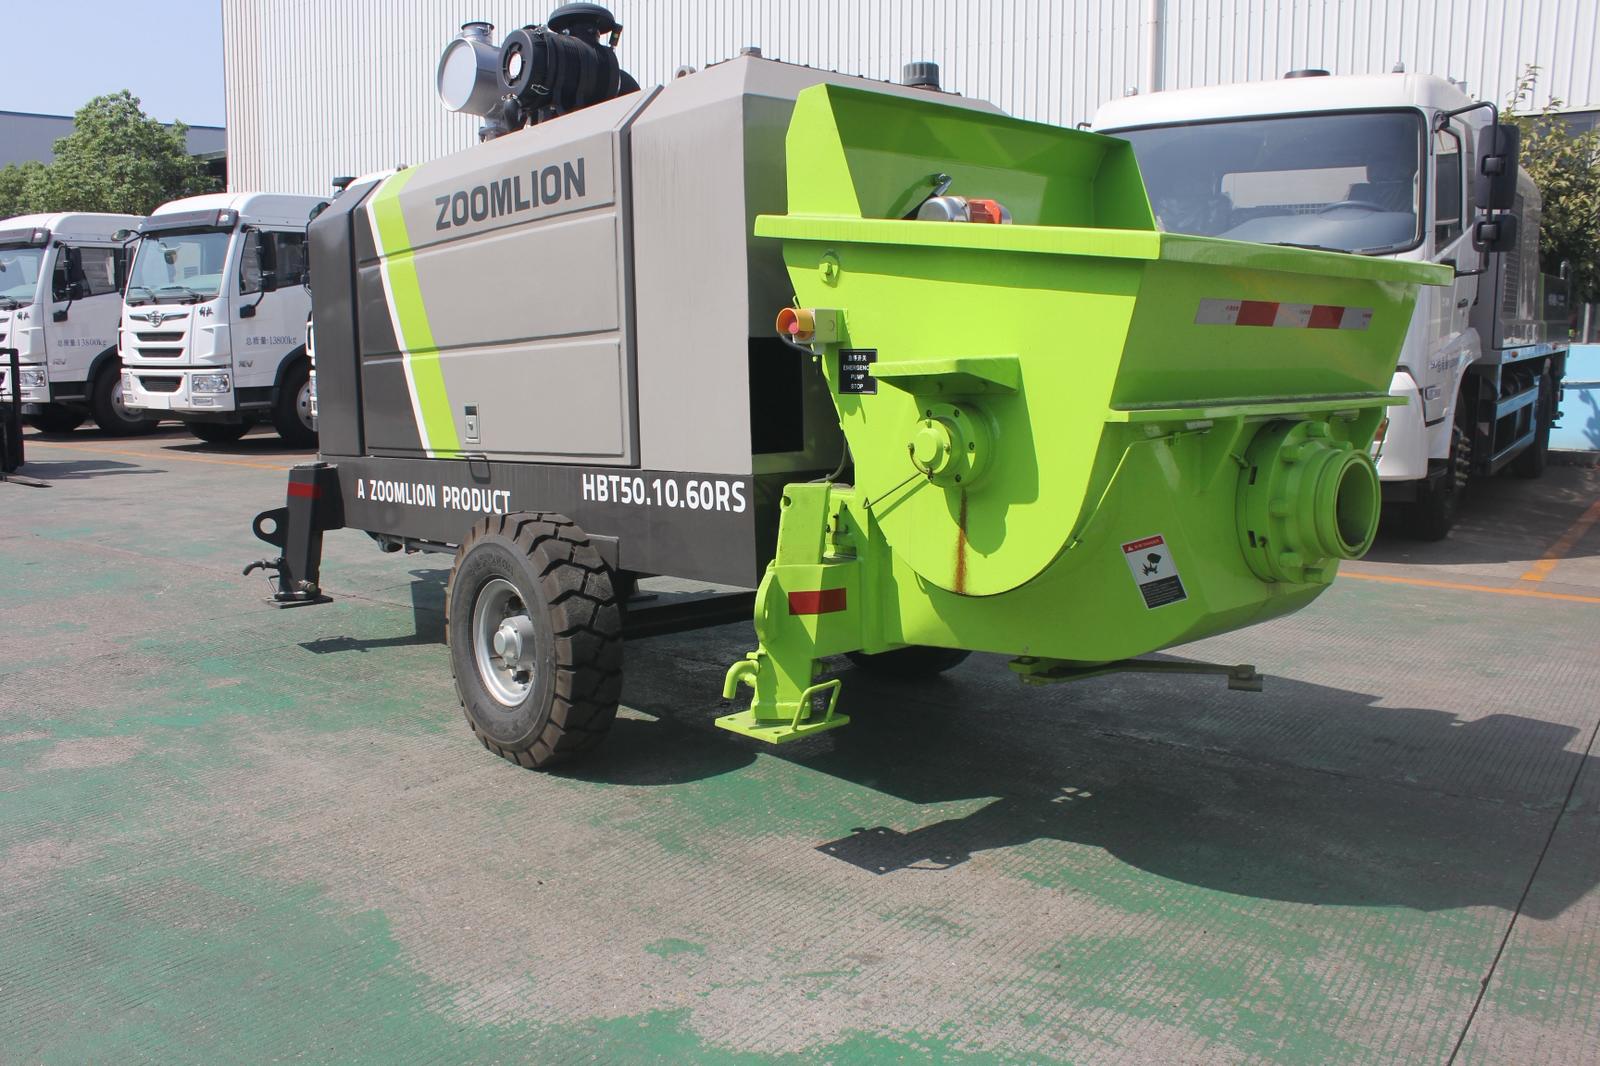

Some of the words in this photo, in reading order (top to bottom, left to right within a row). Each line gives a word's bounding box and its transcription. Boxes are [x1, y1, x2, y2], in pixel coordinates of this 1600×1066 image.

[435, 157, 586, 231] ZOOMLION
[357, 478, 366, 499] A
[369, 479, 436, 508] ZOOMLION
[442, 485, 511, 514] PRODUCT
[582, 473, 747, 513] HBT50.10.60RS
